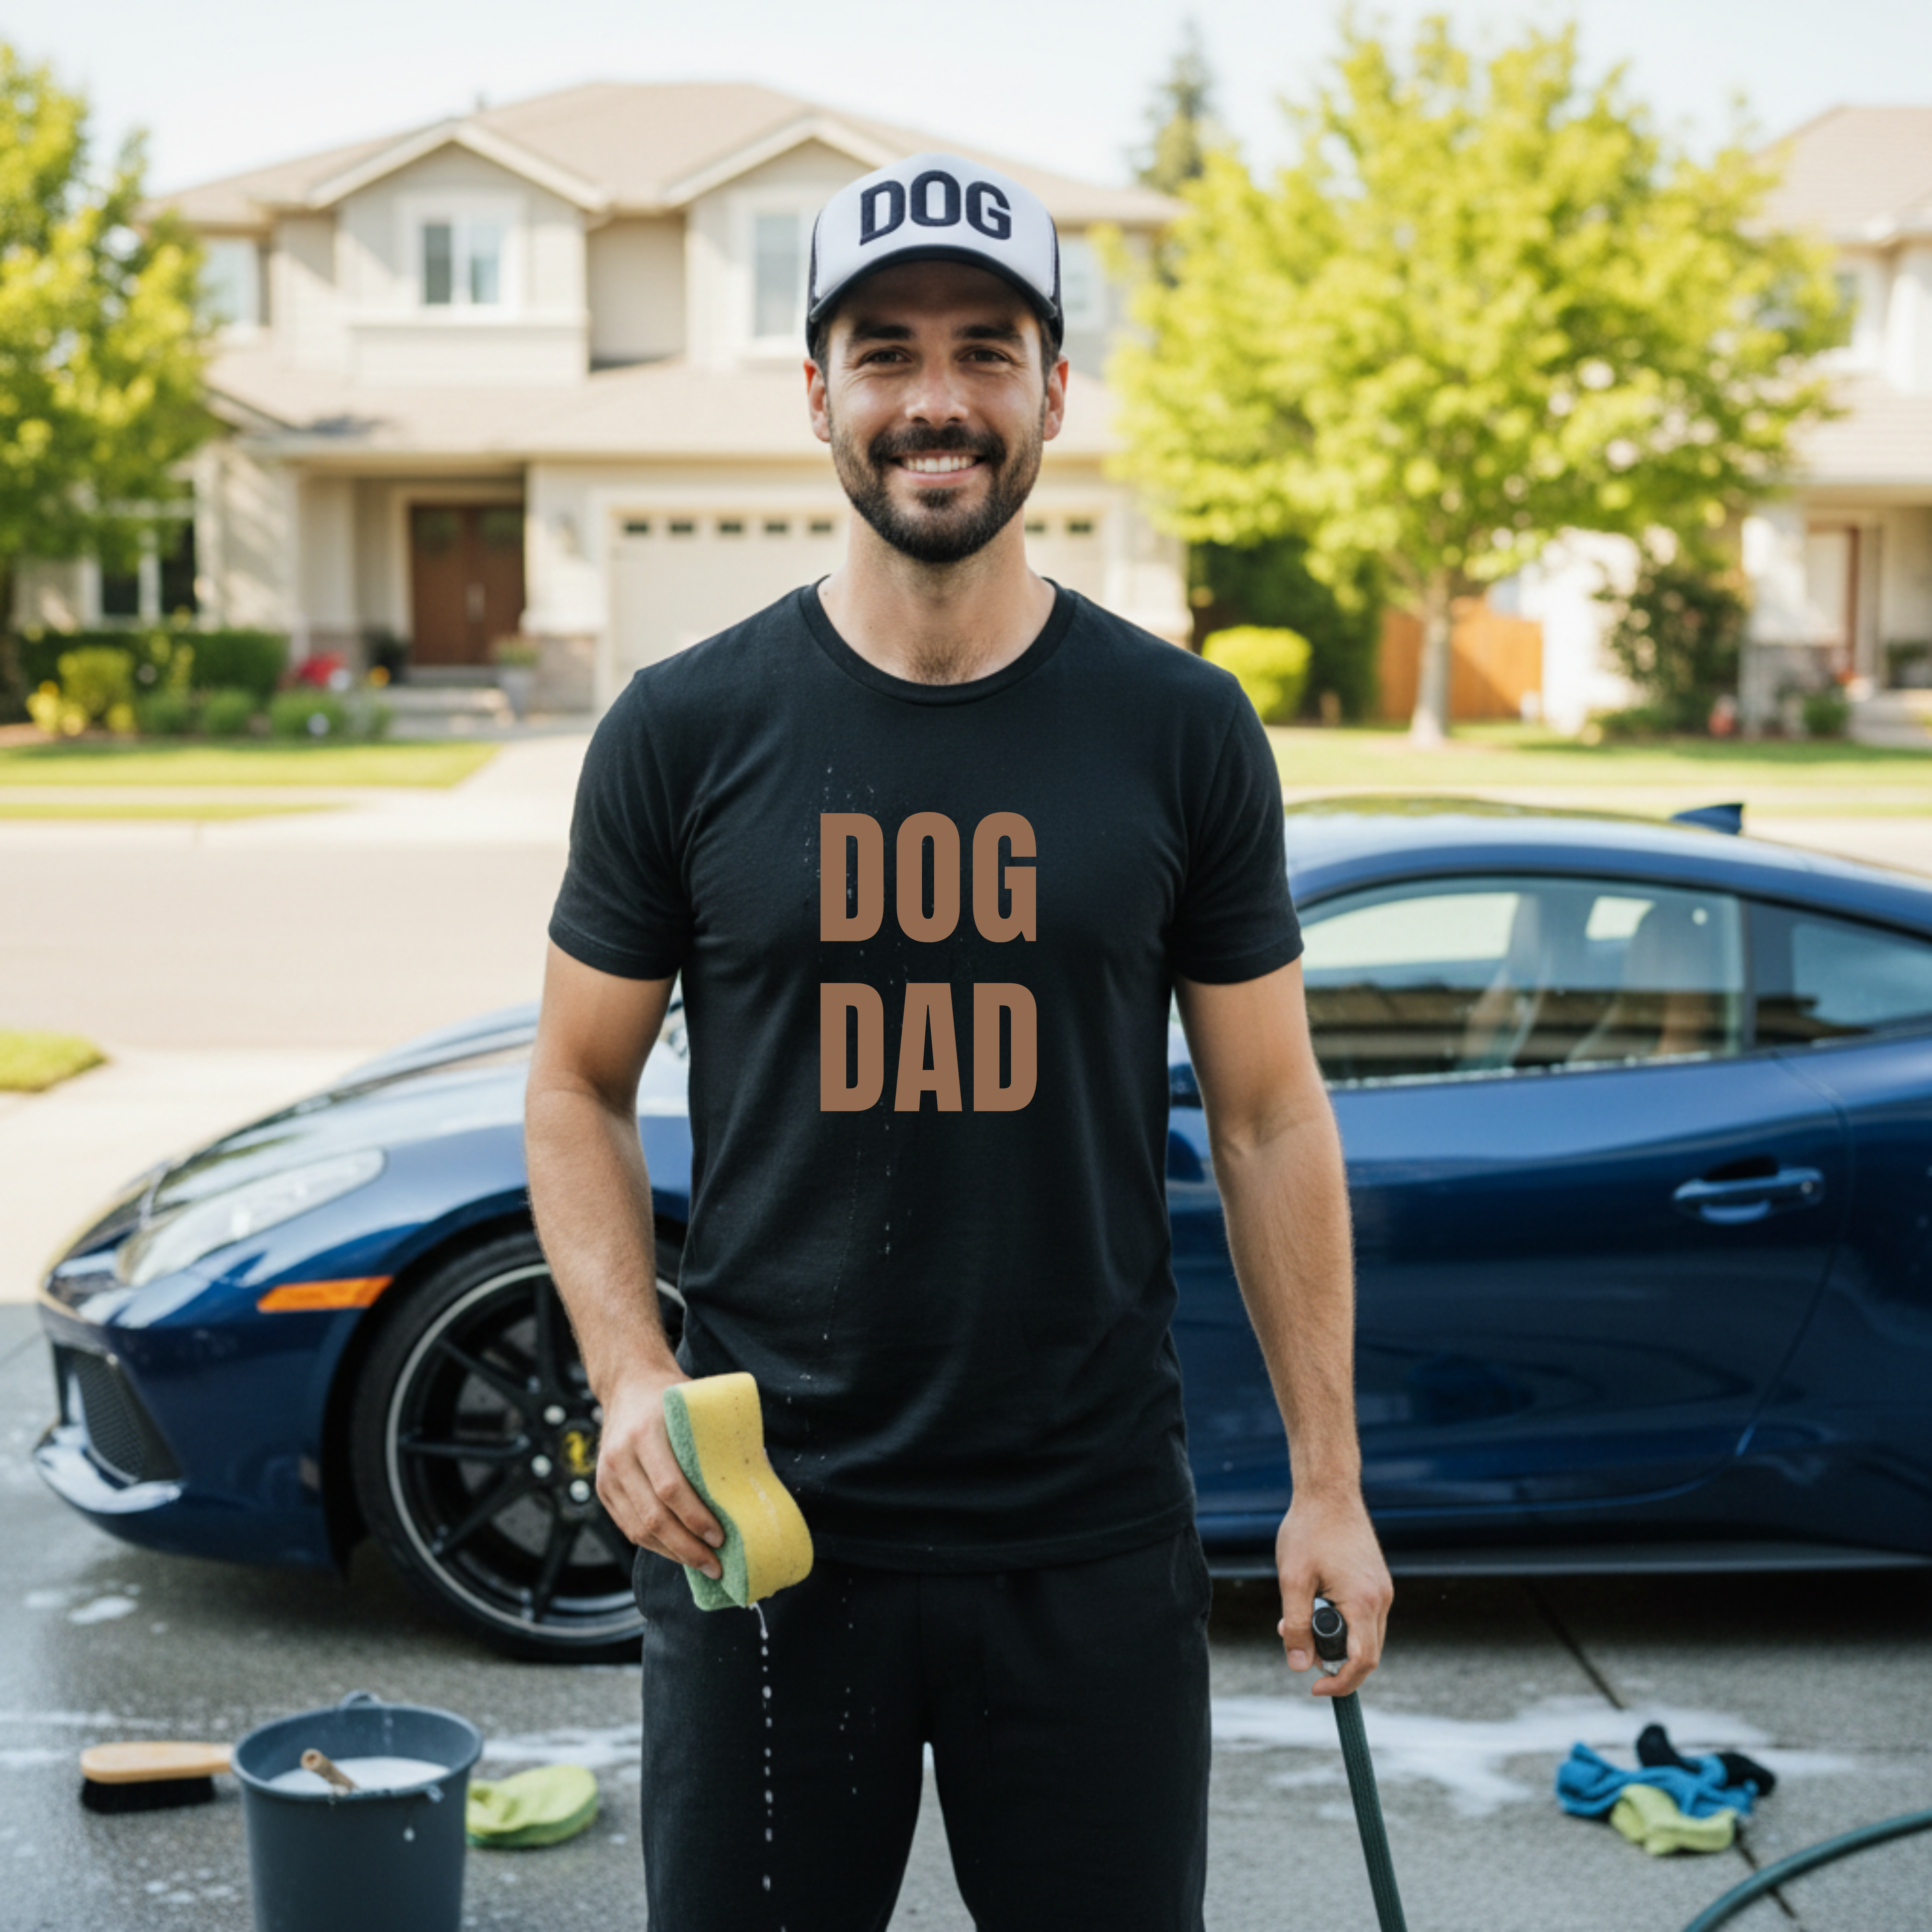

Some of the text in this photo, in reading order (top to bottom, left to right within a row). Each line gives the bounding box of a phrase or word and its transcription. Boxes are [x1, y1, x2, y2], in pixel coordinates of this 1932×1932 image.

[859, 170, 1011, 246] DOG
[820, 812, 1036, 943] DOG
[820, 983, 1037, 1111] DAD
